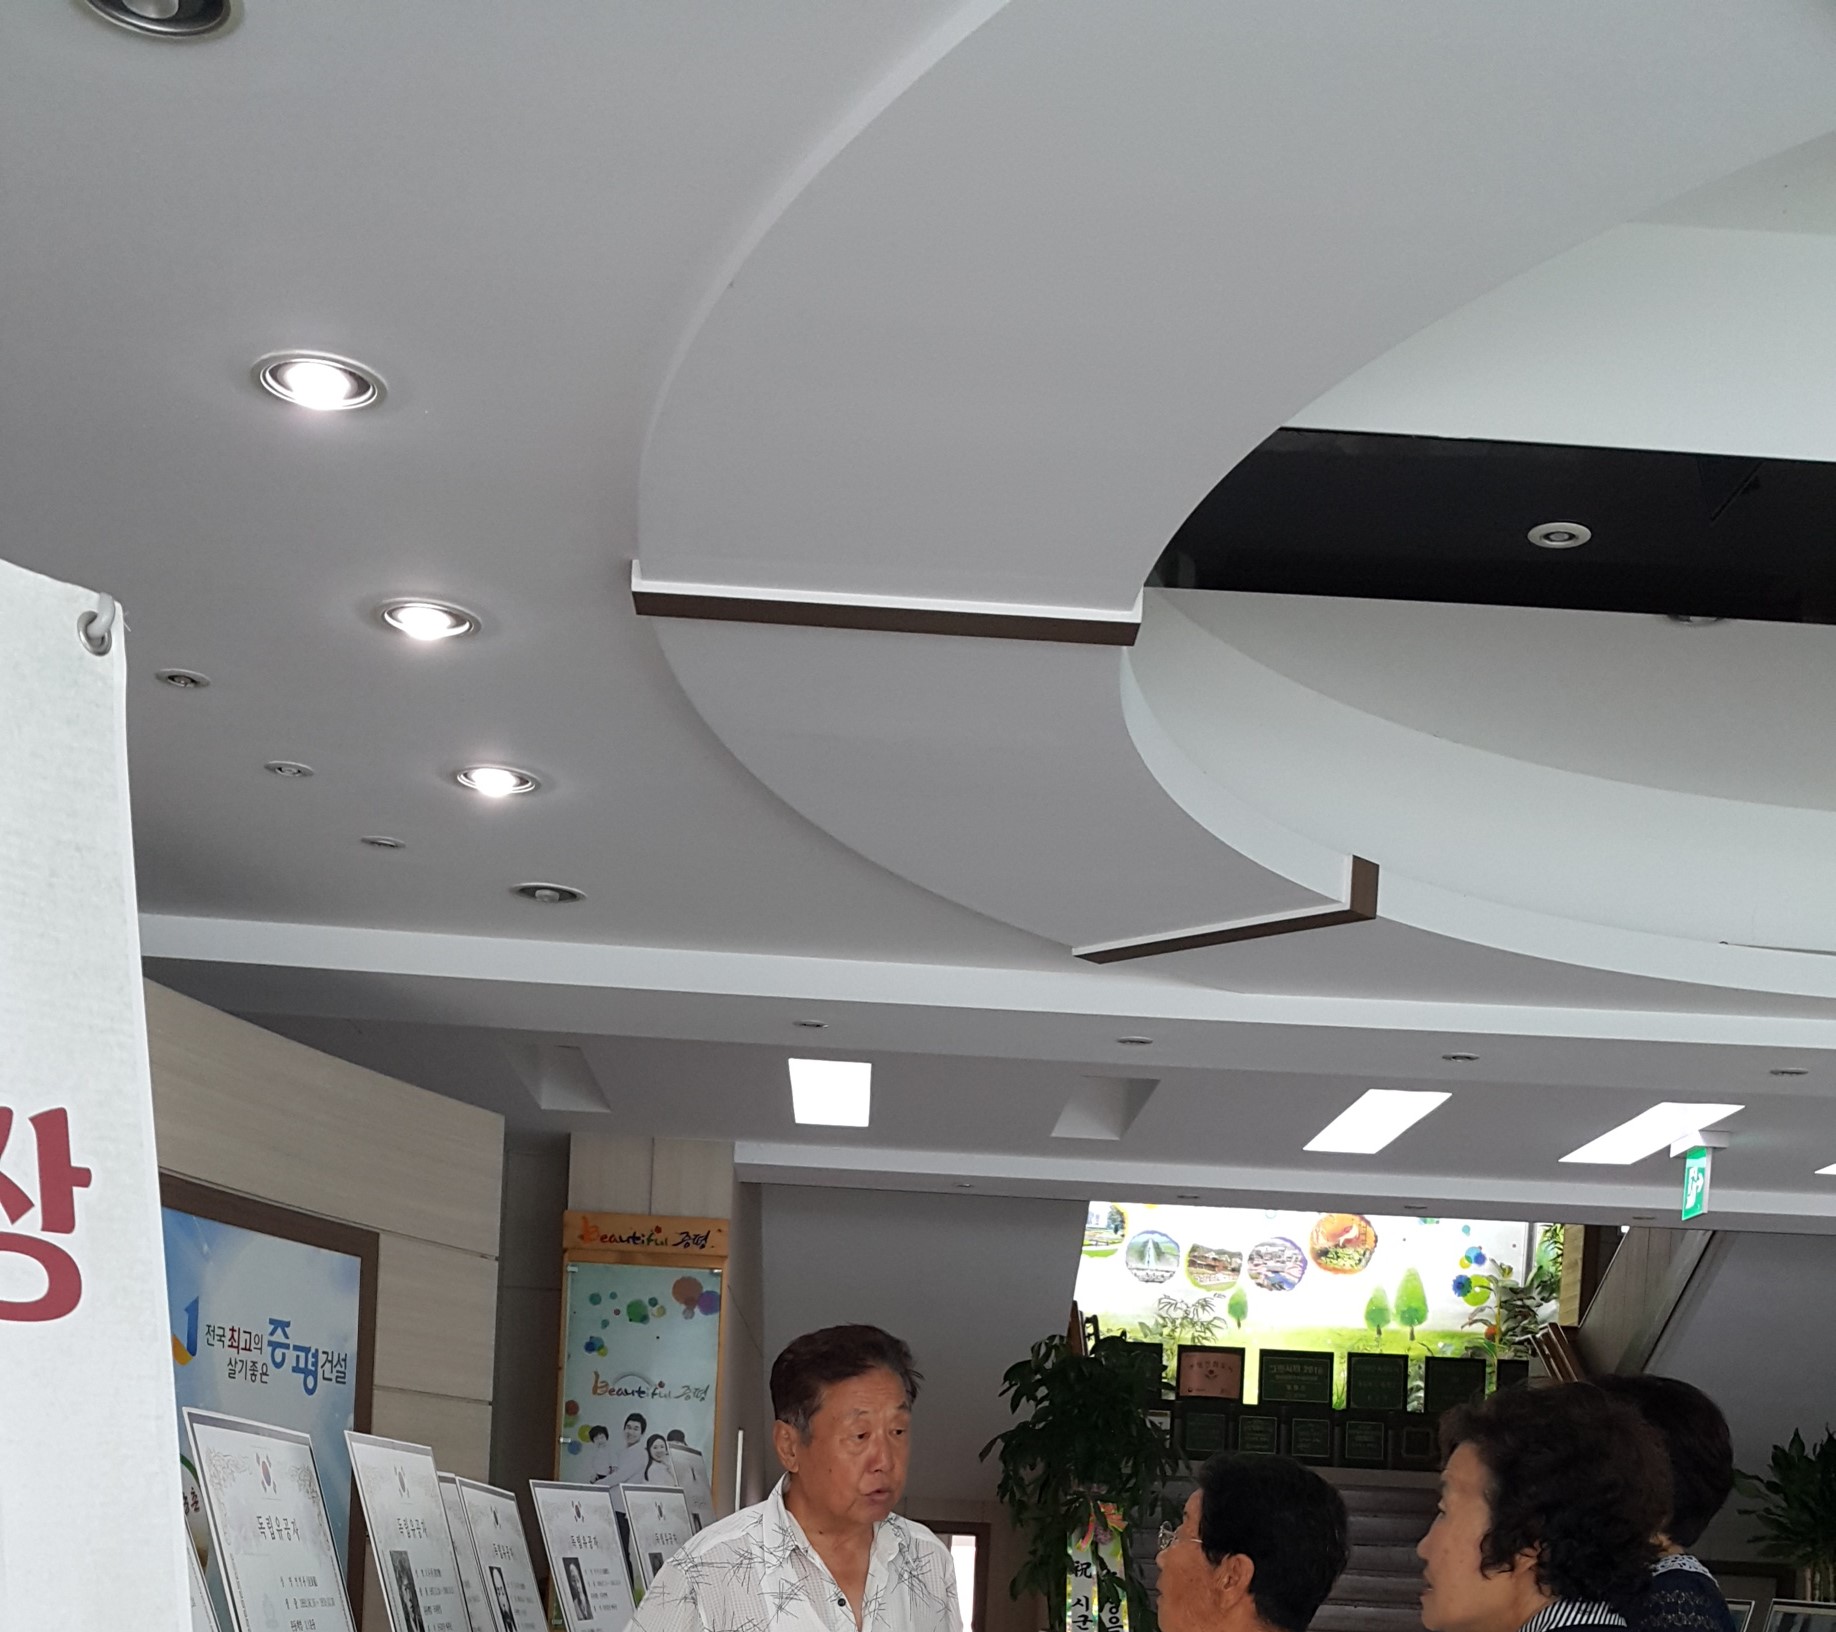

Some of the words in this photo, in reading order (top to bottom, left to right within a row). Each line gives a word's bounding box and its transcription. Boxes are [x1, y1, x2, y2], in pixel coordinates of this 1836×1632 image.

[256, 1515, 300, 1541] 독립유공자
[397, 1518, 427, 1539] 독립유공자
[1074, 1561, 1092, 1579] 祝
